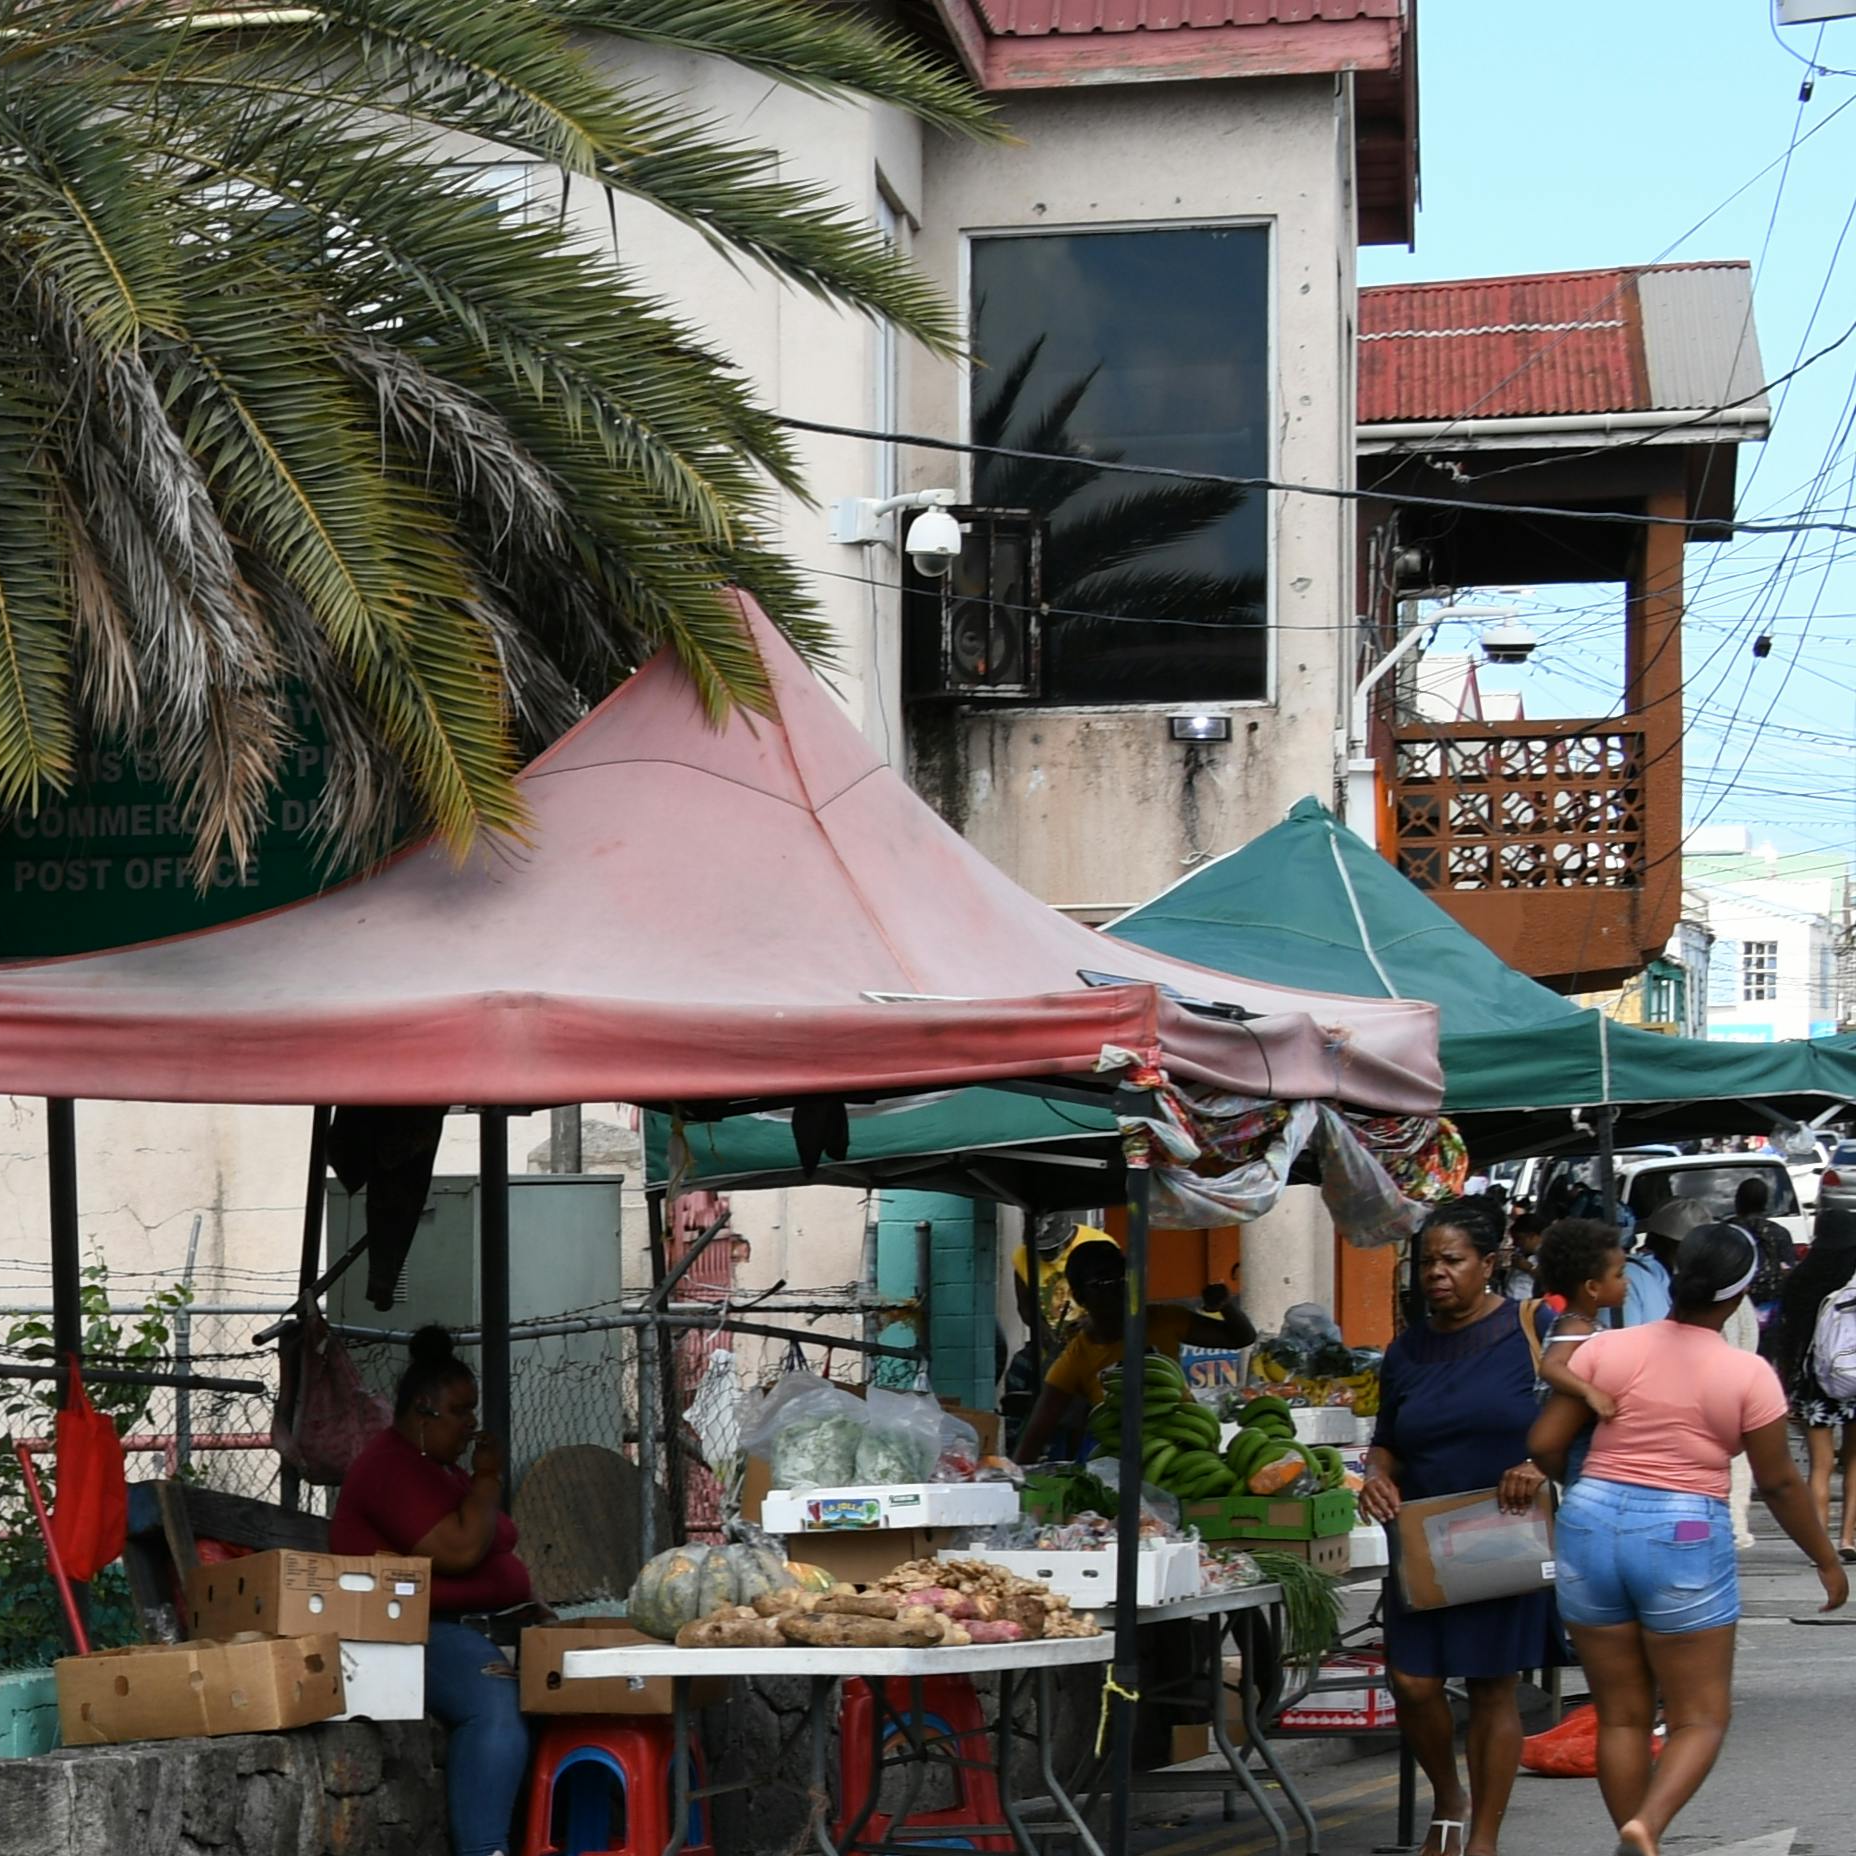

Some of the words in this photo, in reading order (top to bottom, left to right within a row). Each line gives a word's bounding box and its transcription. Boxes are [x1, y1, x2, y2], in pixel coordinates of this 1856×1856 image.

[14, 803, 266, 839] COMMERC
[14, 858, 113, 893] POST
[124, 855, 261, 890] OFFCE
